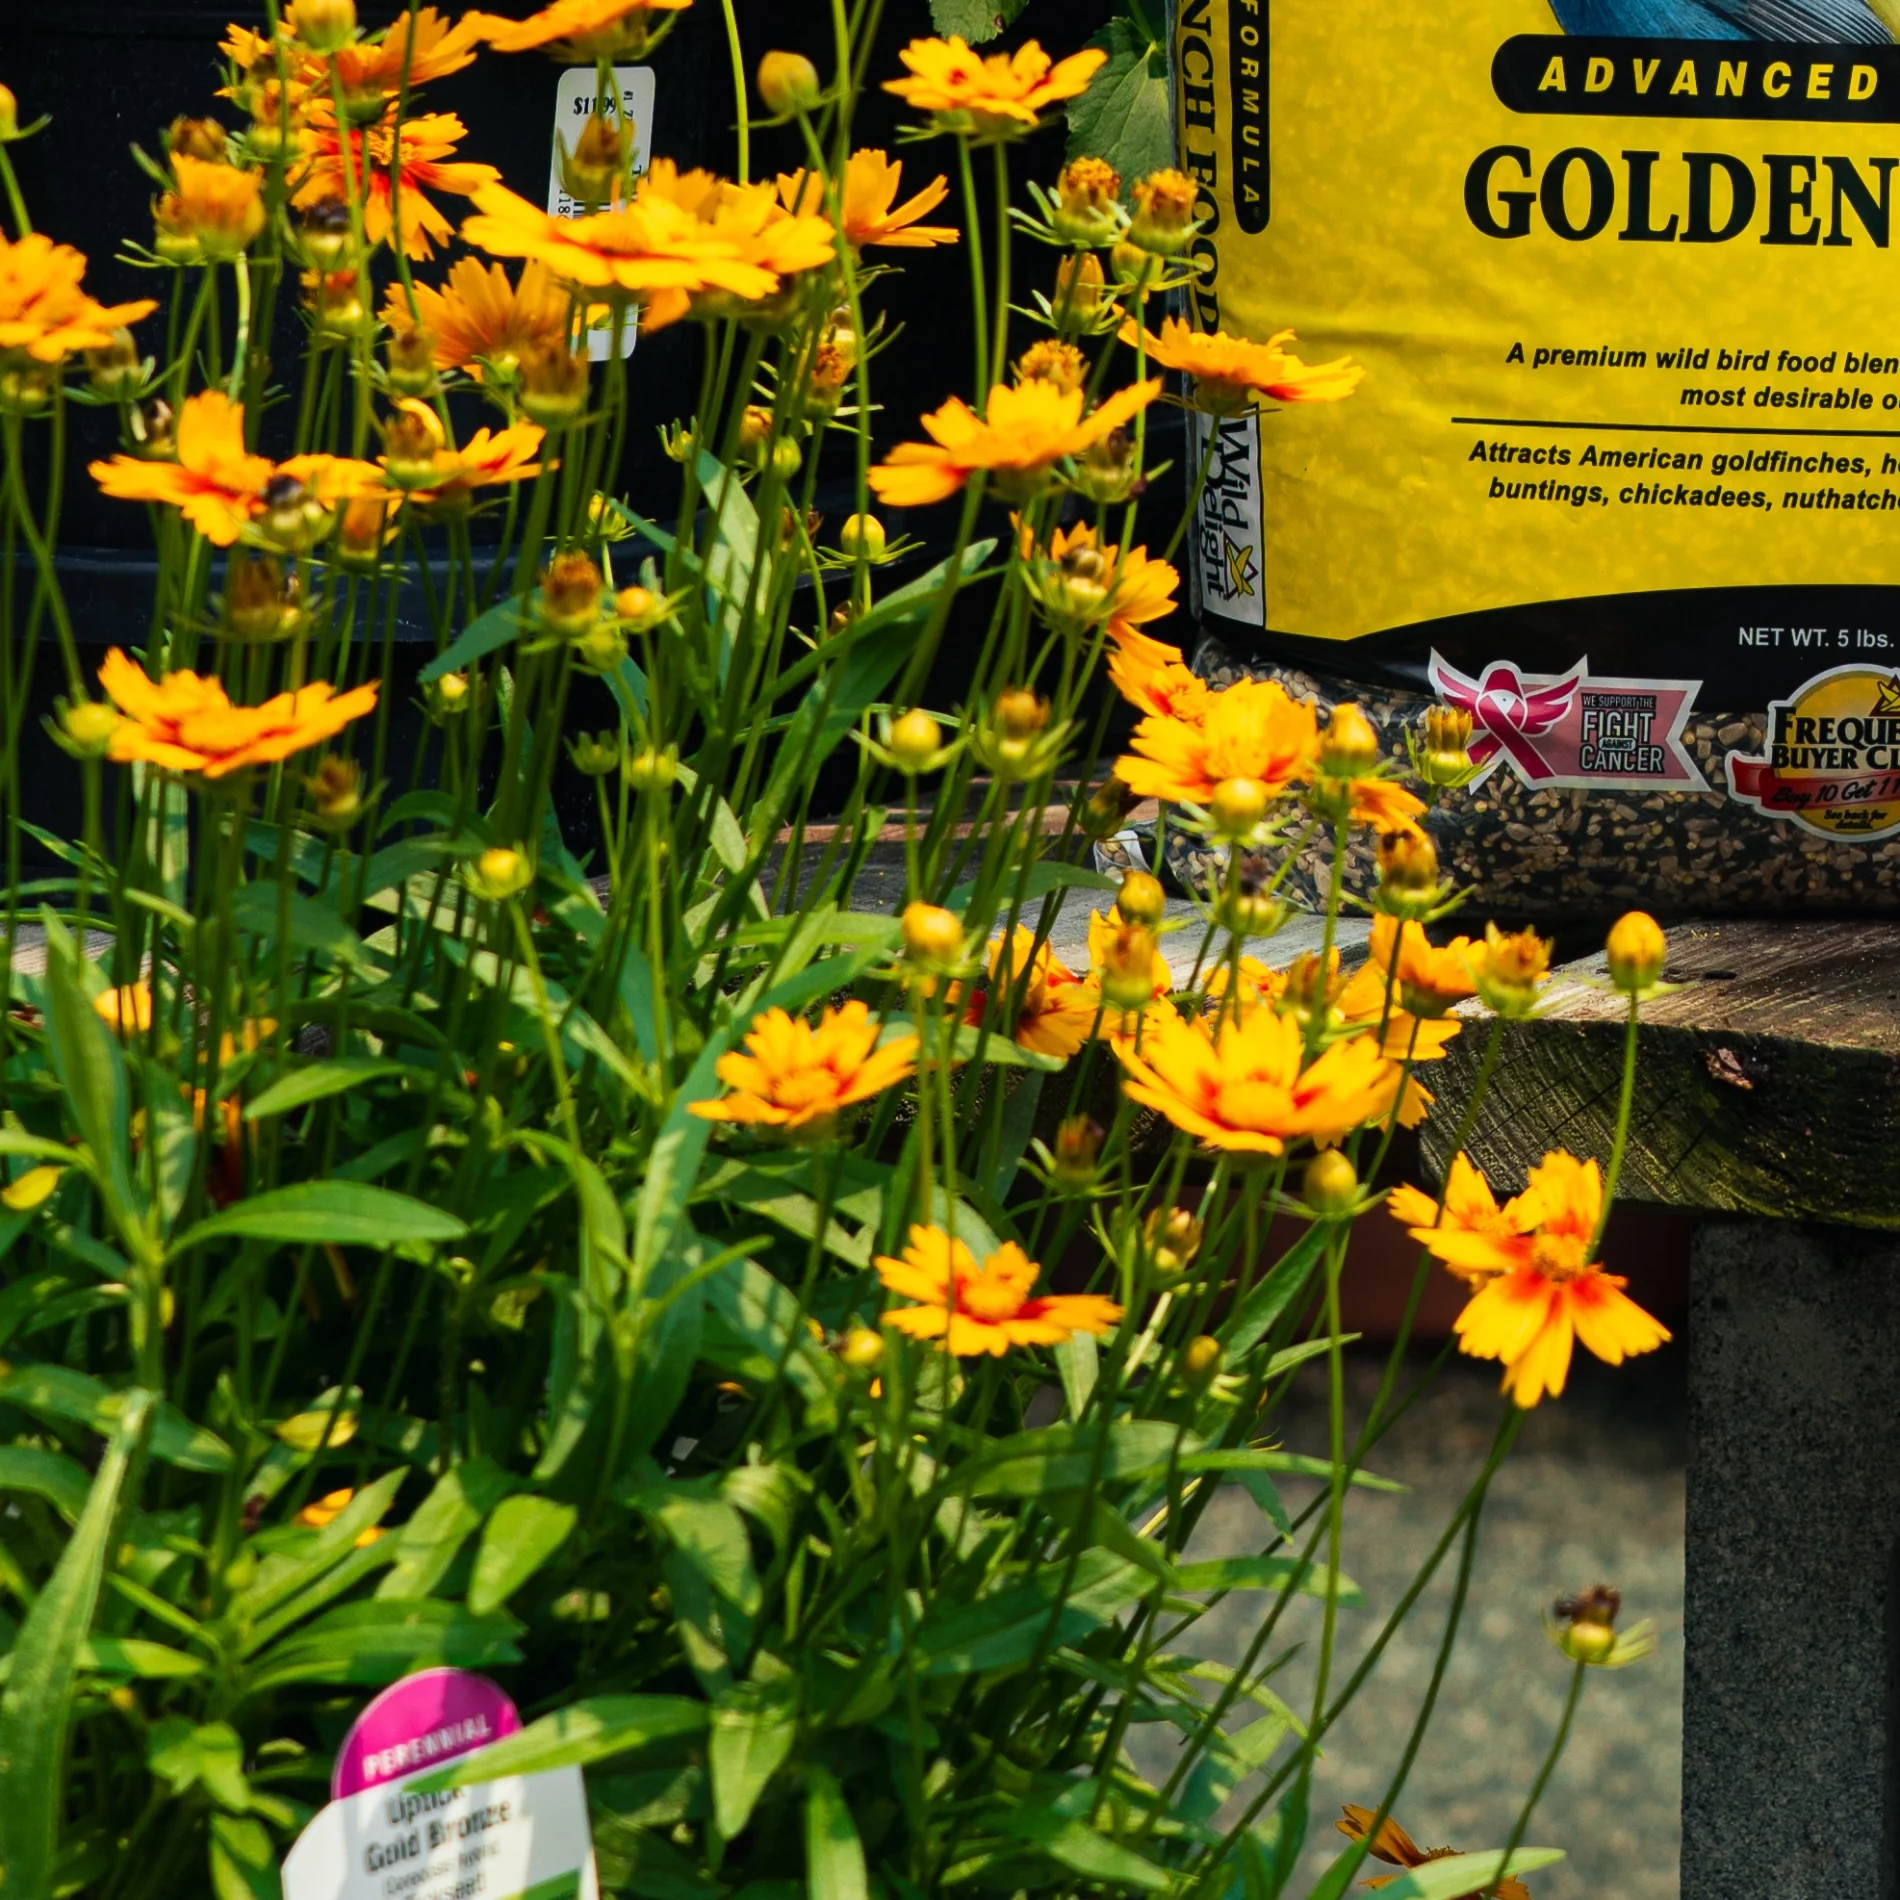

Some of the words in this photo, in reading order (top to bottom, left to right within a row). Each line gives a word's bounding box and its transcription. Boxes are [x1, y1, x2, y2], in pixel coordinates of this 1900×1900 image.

[1539, 55, 1879, 100] ADVANCED
[573, 96, 617, 116] $1199
[1506, 342, 1525, 365] A
[1532, 345, 1647, 369] premium
[1655, 348, 1710, 370] wild
[1716, 349, 1770, 372] bird
[1777, 350, 1836, 373] food
[1680, 386, 1746, 407] most
[1753, 386, 1873, 410] desirable
[1469, 440, 1572, 467] Attracts
[1578, 444, 1703, 471] American
[1711, 448, 1872, 477] goldfinches,
[1218, 419, 1251, 531] Wild
[1488, 476, 1610, 506] buntings,
[1618, 482, 1774, 512] chickadees,
[1738, 627, 1784, 646] NET
[1791, 628, 1830, 647] WT.
[1837, 629, 1850, 647] 5
[1856, 629, 1894, 648] lbs.
[1583, 695, 1596, 707] WE
[1598, 695, 1637, 709] SUPPORT
[1639, 697, 1653, 709] THE
[1583, 710, 1654, 743] FIGHT
[1581, 745, 1664, 772] CANCER
[1771, 745, 1860, 770] BUYER
[1773, 785, 1814, 810] Buy
[1815, 783, 1838, 803] 10
[1841, 780, 1873, 802] Get
[1877, 777, 1887, 797] 1
[1823, 809, 1844, 821] See
[1845, 808, 1871, 821] back
[1870, 809, 1888, 822] for
[362, 1714, 492, 1782] PERENNIAL
